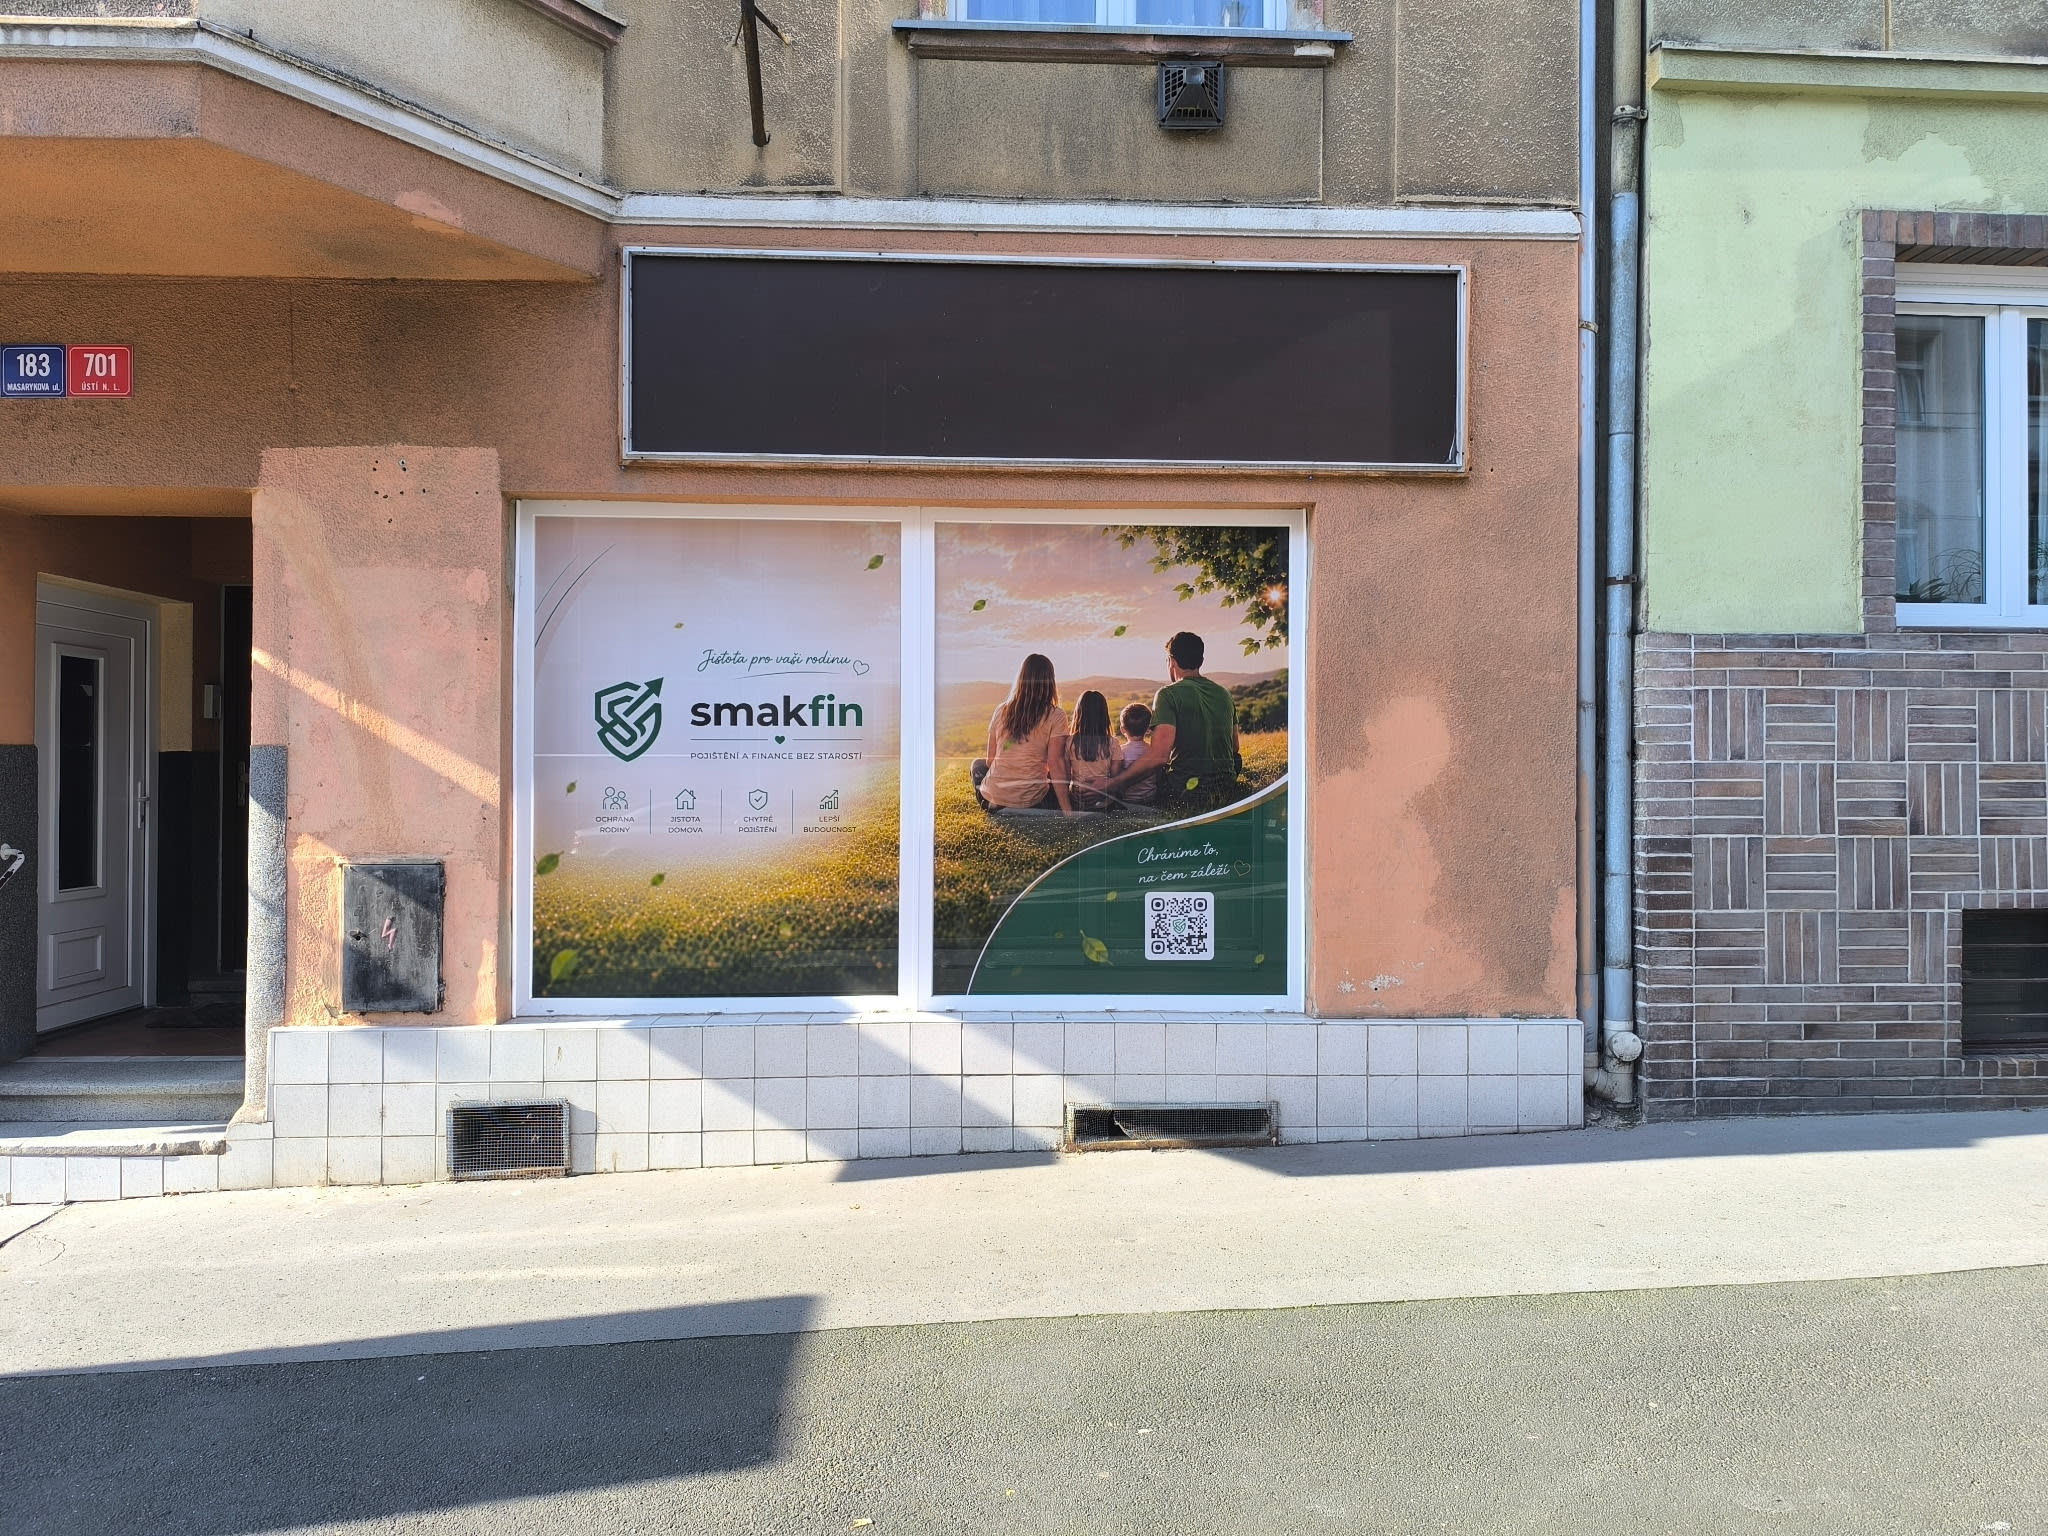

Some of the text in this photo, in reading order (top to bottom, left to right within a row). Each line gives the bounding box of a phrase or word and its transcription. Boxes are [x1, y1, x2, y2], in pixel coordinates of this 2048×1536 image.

[16, 353, 51, 377] 183
[83, 353, 116, 377] 701
[7, 383, 60, 391] MASARYKOVA ul.
[81, 381, 98, 391] ÚSTÍ
[697, 649, 748, 672] Jistota
[748, 655, 773, 672] pro
[805, 650, 851, 665] rodinu
[690, 693, 863, 727] smakfin
[690, 751, 862, 760] POJIŠTĚNÍ A FINANCE BEZ STAROSTÍ
[743, 814, 773, 823] CHYTRÉ
[818, 814, 840, 823] LEPŠÍ
[738, 825, 777, 833] POJIŠTĚNÍ
[1202, 841, 1218, 856] to,
[1138, 862, 1230, 884] na čem záleží
